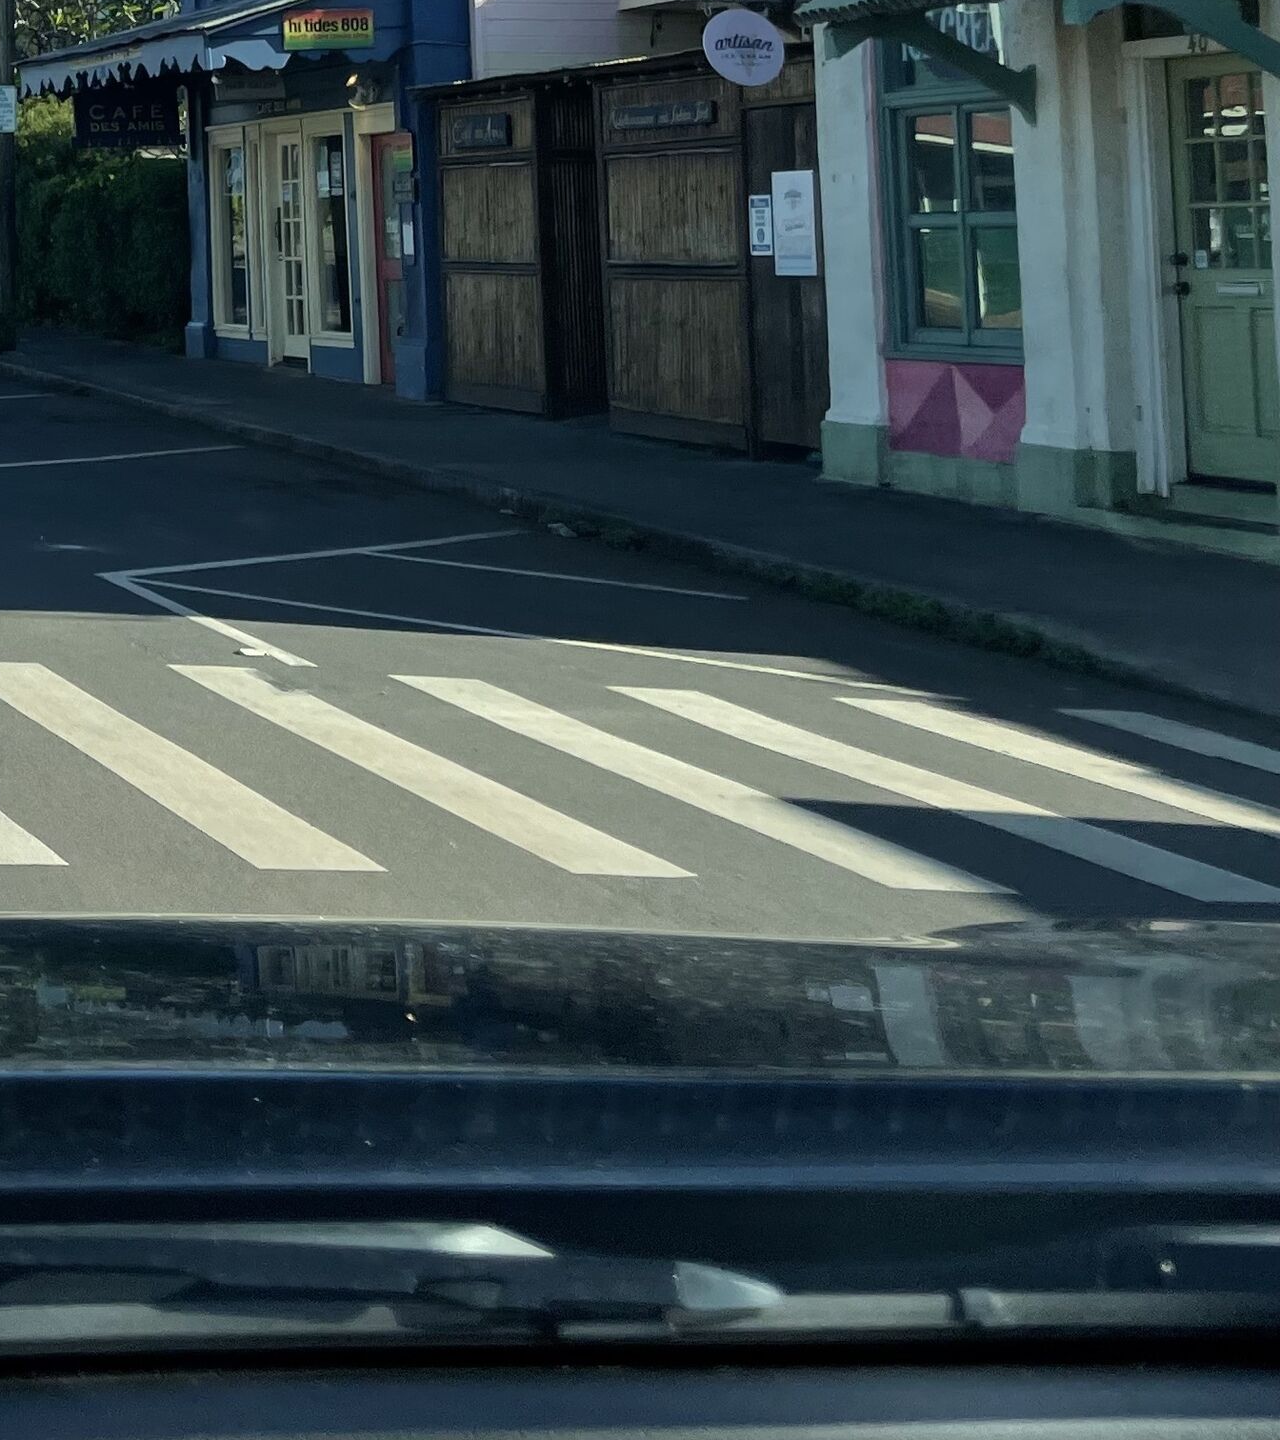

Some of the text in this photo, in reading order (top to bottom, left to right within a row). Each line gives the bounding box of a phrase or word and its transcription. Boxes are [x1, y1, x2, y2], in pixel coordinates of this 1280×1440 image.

[289, 17, 369, 32] hi tides 808
[715, 34, 773, 51] artisan
[90, 120, 165, 133] DES AMIS
